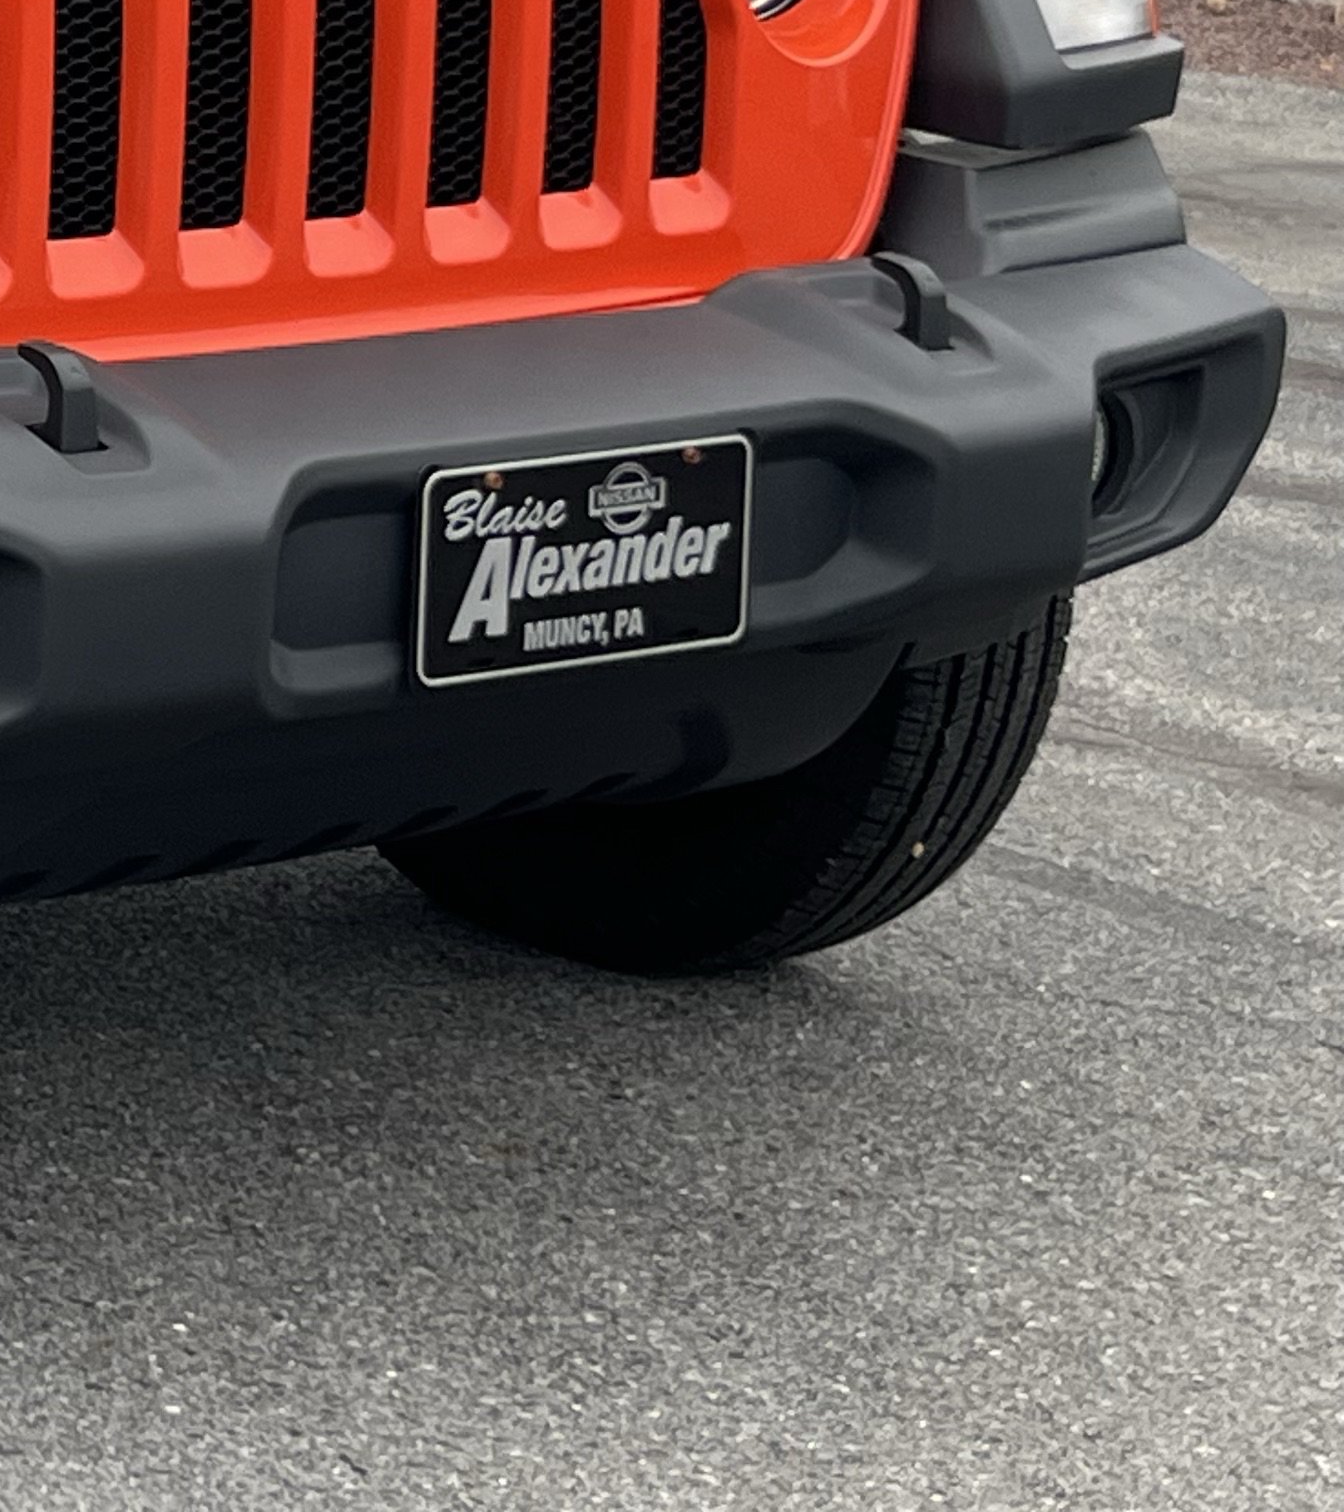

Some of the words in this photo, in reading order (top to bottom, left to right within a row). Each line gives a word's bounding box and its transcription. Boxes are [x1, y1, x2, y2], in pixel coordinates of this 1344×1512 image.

[443, 488, 568, 542] Blaise
[597, 484, 657, 507] NISSAN
[447, 515, 732, 643] Alexander
[522, 614, 609, 652] MUNCY,
[614, 606, 646, 639] PA
